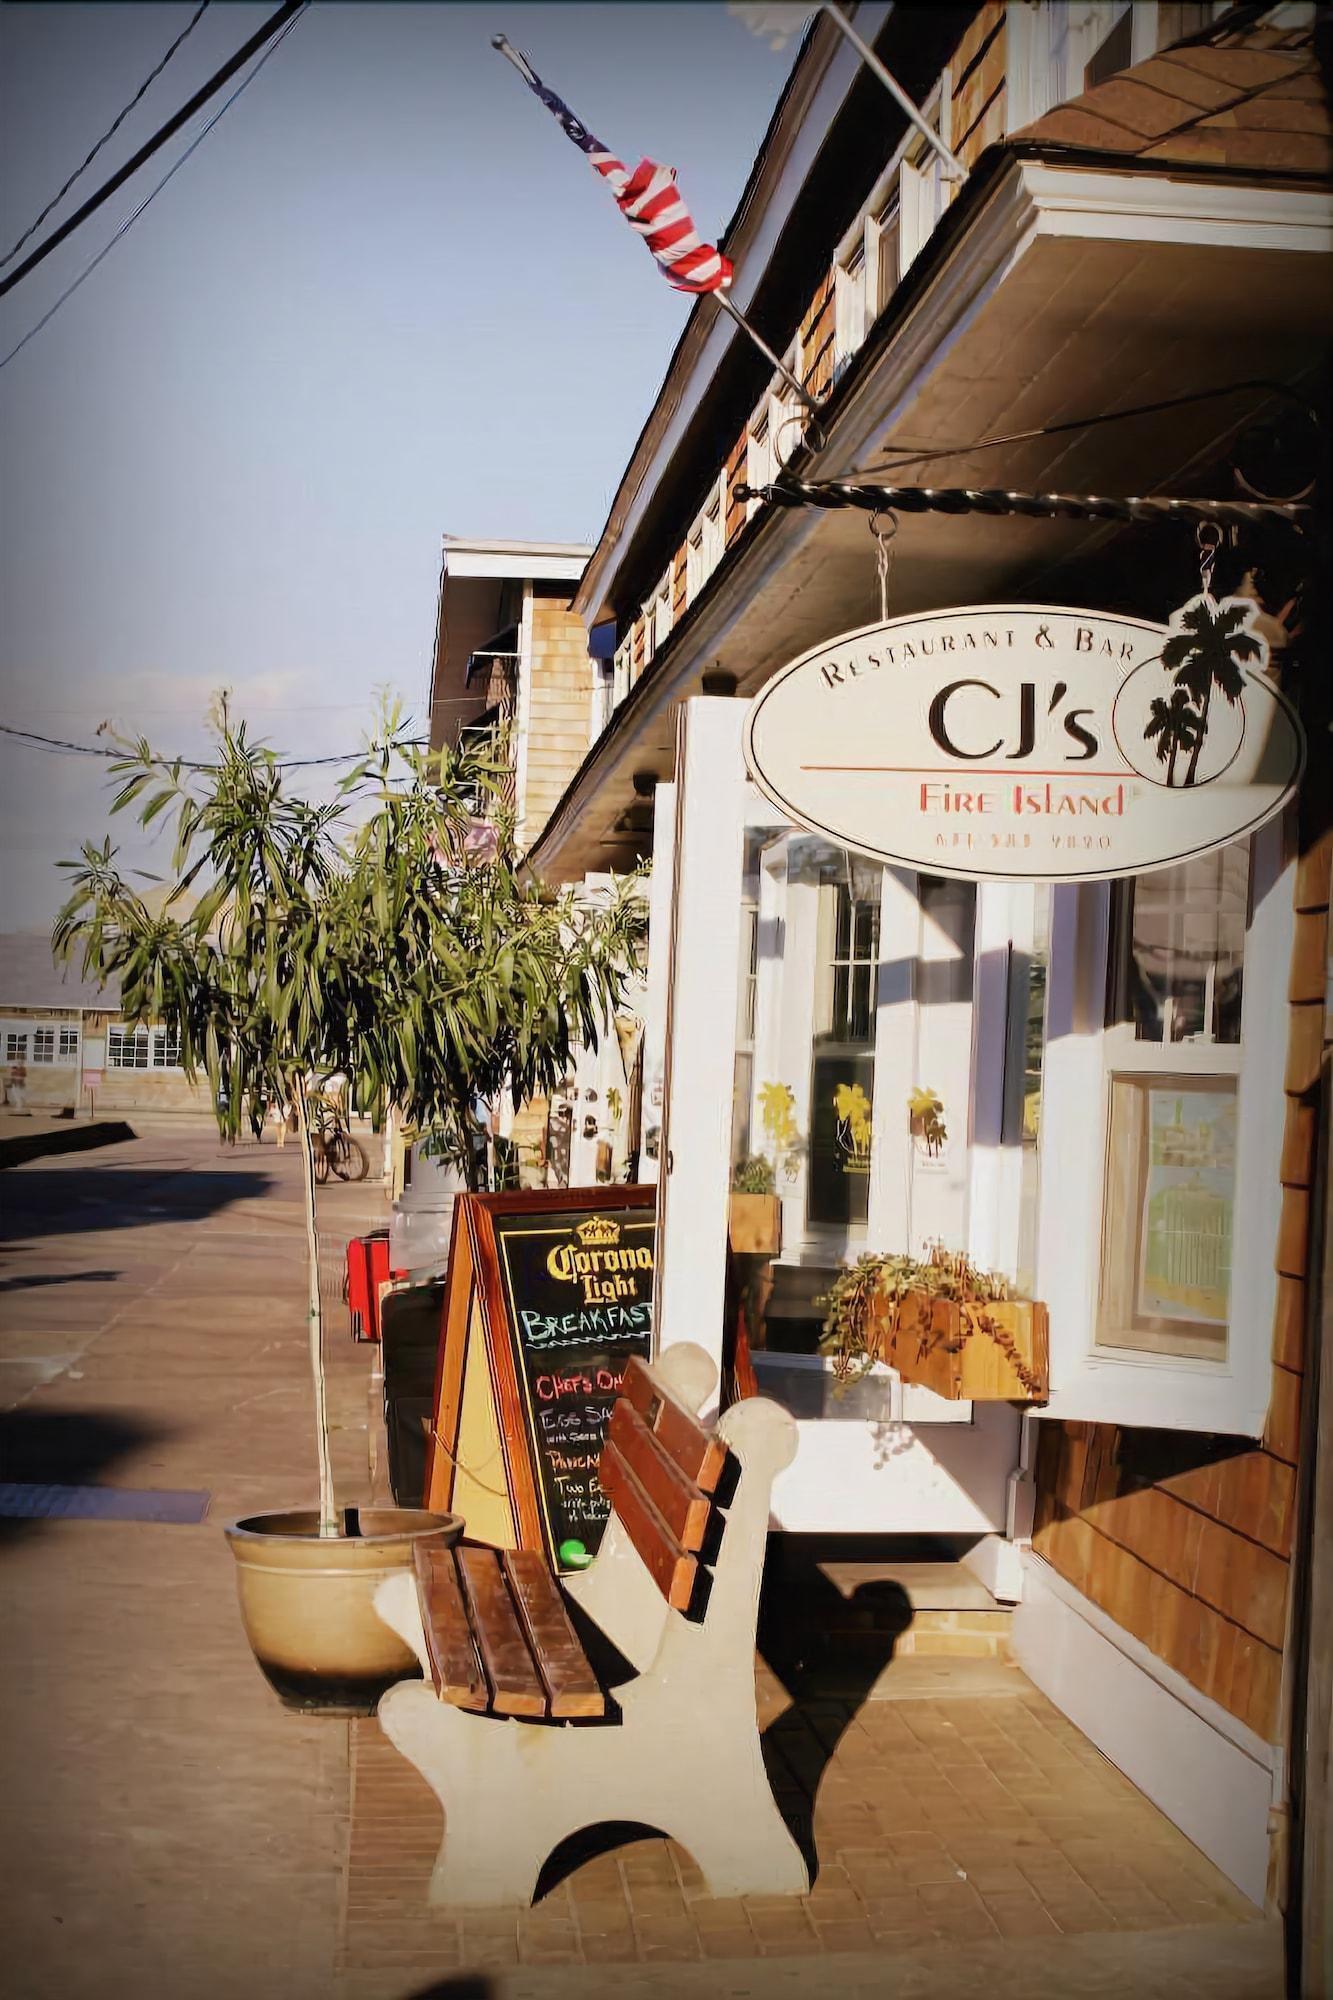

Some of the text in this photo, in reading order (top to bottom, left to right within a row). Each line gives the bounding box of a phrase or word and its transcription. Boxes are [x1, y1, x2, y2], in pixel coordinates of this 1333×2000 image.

[820, 623, 1134, 688] RESTAURANT & BAR
[928, 678, 1099, 761] CJ's
[546, 1244, 654, 1284] Corona
[580, 1274, 639, 1304] Light
